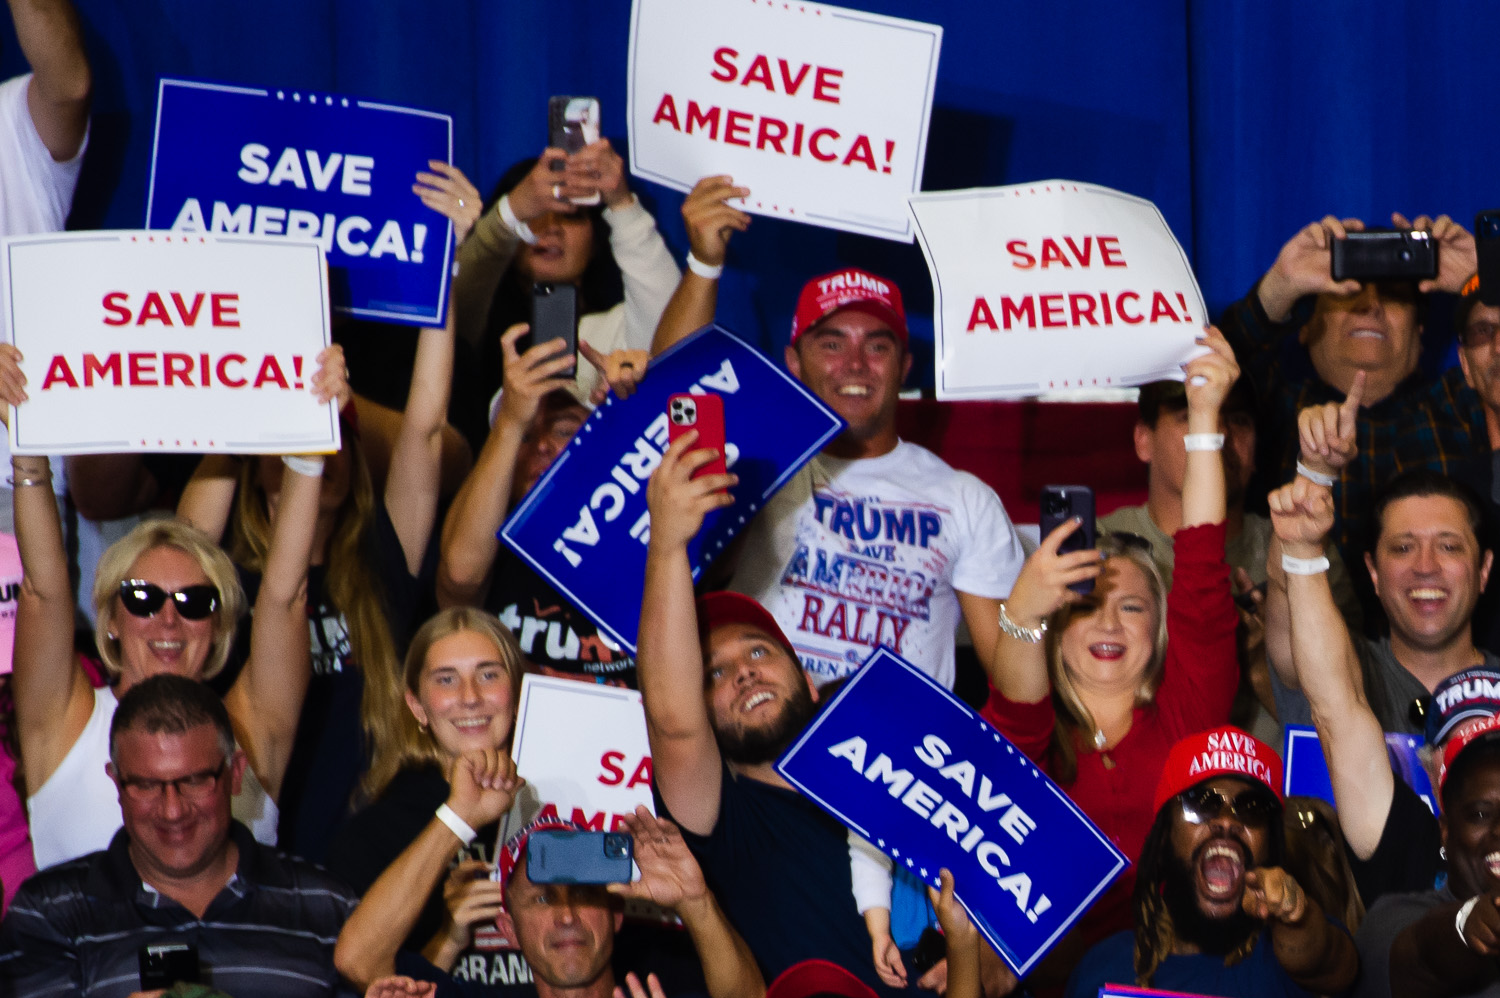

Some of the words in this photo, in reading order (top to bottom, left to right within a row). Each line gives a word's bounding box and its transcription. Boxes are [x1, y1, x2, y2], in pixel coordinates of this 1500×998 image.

[709, 46, 845, 105] SAVE
[652, 93, 897, 175] AMERICA!
[238, 143, 376, 197] SAVE
[170, 198, 428, 265] AMERICA!
[1004, 235, 1129, 270] SAVE
[101, 291, 241, 328] SAVE
[817, 272, 890, 297] TRUMP
[965, 291, 1193, 333] AMERICA!
[41, 352, 305, 391] AMERICA!
[553, 358, 741, 569] AERICA!
[814, 493, 943, 549] TRUMP
[797, 593, 912, 656] RALLY
[1189, 751, 1272, 786] AMERICA
[1207, 731, 1256, 757] SAVE
[913, 733, 1037, 845] SAVE
[827, 734, 1053, 924] AMERICA!
